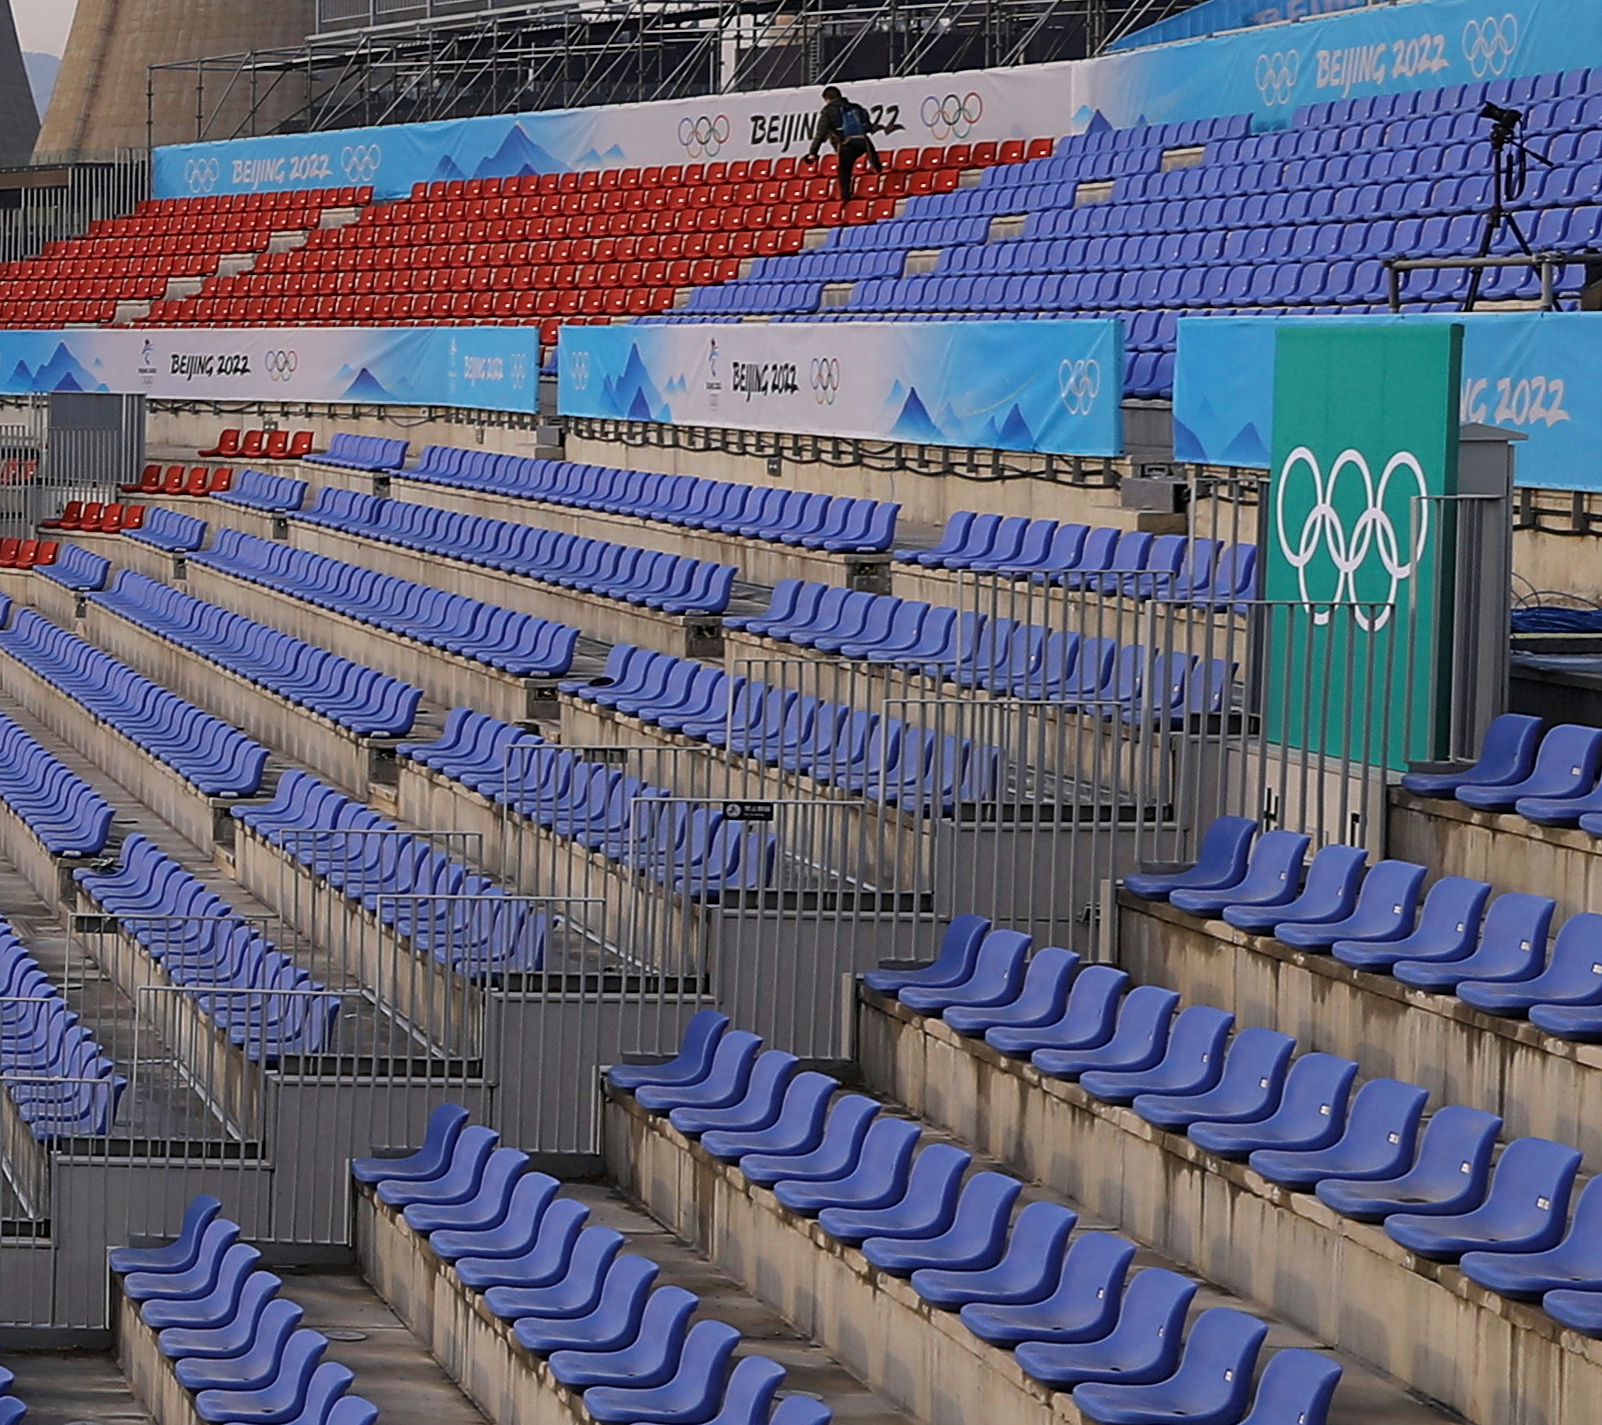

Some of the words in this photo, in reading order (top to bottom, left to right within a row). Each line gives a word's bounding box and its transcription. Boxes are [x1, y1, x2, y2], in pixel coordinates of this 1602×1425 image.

[1316, 43, 1387, 98] BEIJING
[1392, 34, 1450, 79] 2022
[750, 112, 819, 153] BEIJIN
[232, 159, 286, 190] BEIJING
[290, 153, 333, 180] 2022
[171, 354, 214, 381] BEIJING
[216, 355, 251, 376] 2022
[733, 362, 770, 402] BEIJING
[771, 363, 799, 394] 2022
[1494, 375, 1572, 427] 2022
